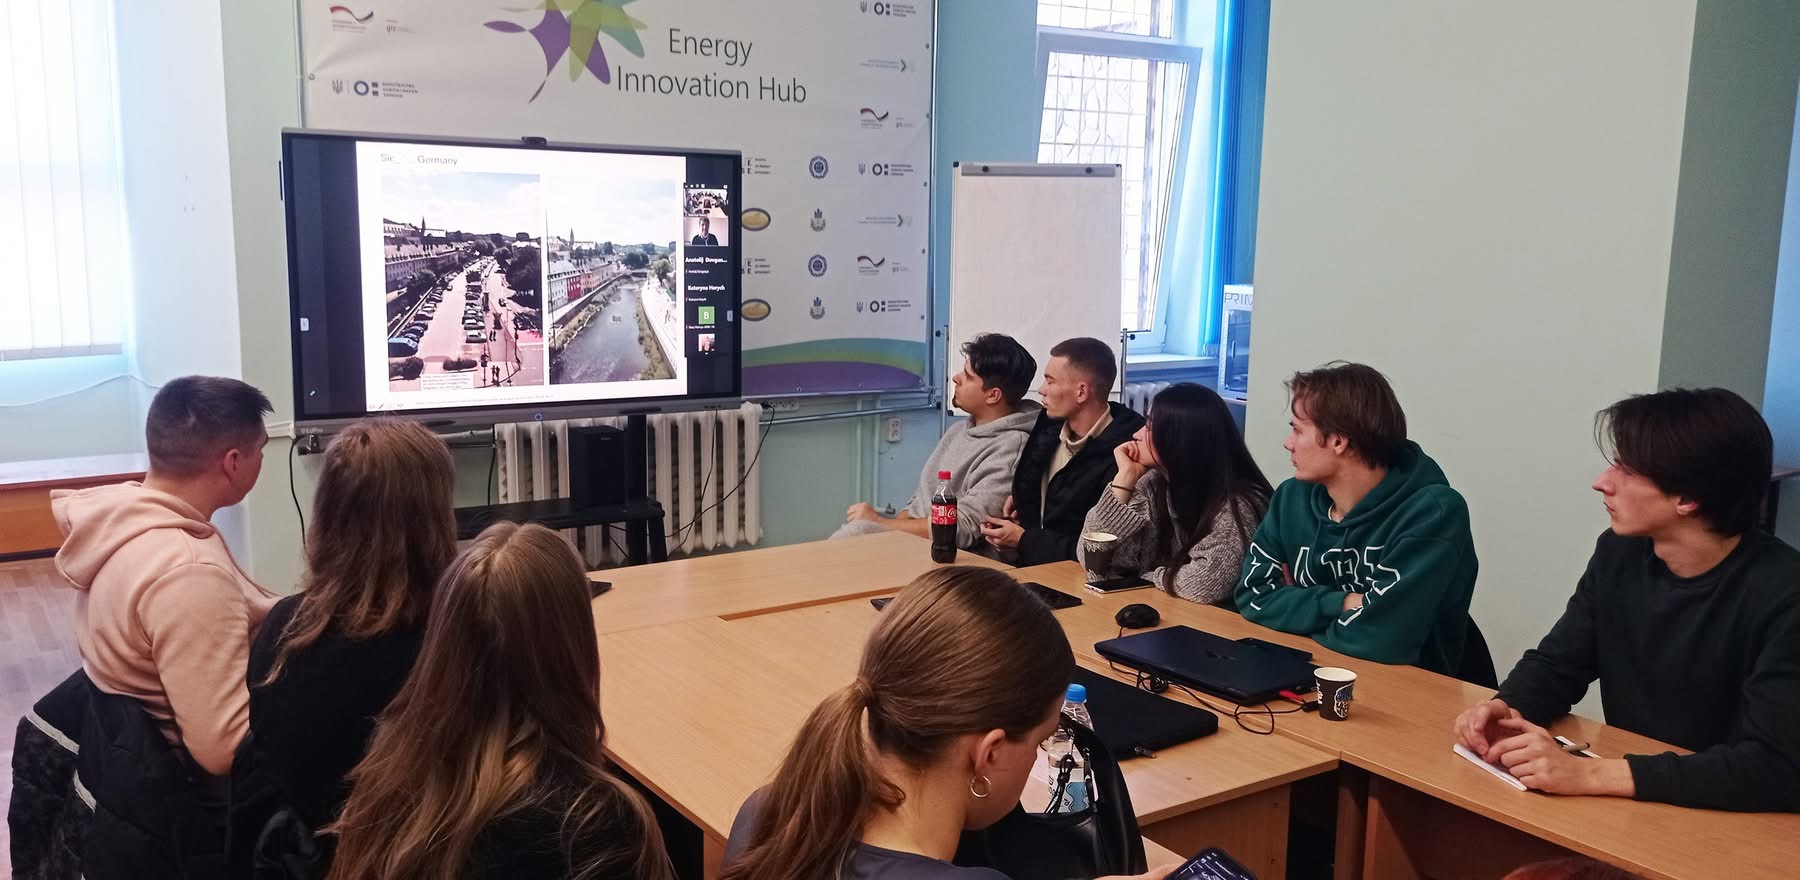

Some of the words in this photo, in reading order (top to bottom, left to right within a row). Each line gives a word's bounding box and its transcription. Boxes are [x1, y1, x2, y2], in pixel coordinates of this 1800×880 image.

[669, 28, 752, 67] Energy
[617, 65, 749, 99] Innovation
[759, 76, 806, 103] Hub
[417, 155, 458, 166] Germany
